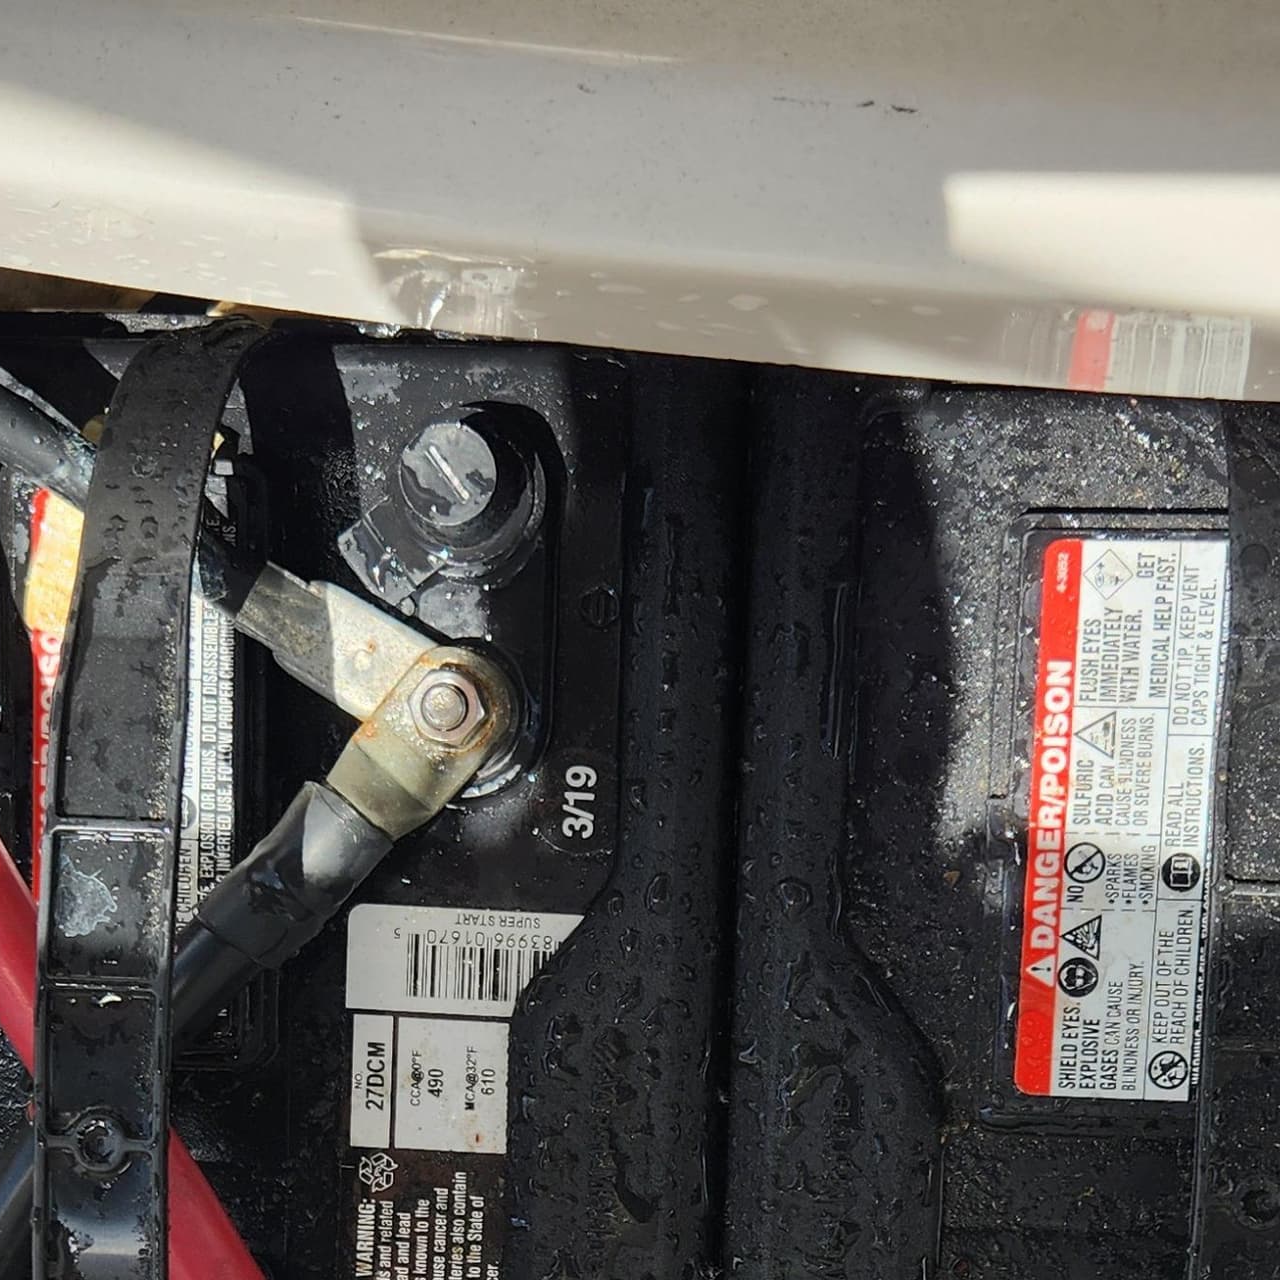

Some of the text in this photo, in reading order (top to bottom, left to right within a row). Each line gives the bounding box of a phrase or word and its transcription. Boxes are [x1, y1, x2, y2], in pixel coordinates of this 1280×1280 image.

[1137, 552, 1155, 578] GET
[1099, 607, 1123, 702] IMMEDIATELY
[1119, 609, 1142, 702] WITH WATER.
[1149, 552, 1176, 697] MEDICAL HELP FAST.
[1173, 565, 1199, 725] DO NOT TIP. KEEP VENT
[1191, 578, 1217, 725] CAPS TIGHT & LEVEL.
[1079, 618, 1101, 701] FLUSH EYES
[201, 727, 217, 742] DO
[202, 697, 217, 723] NOT
[217, 683, 234, 728] PROPER
[216, 733, 233, 781] FOLLOW
[1073, 759, 1093, 824] SULFURIC
[1115, 718, 1136, 825] CAUSE BLINDNESS
[1133, 712, 1155, 825] OR SEVERE BURNS.
[200, 793, 216, 809] OR
[562, 765, 597, 839] 3/19
[1030, 660, 1074, 948] DANGER/POISON
[1095, 764, 1114, 824] ACID CAN
[1165, 782, 1184, 846] READ ALL
[1182, 742, 1205, 847] INSTRUCTIONS.
[200, 813, 216, 878] EXPLOSION
[456, 913, 540, 928] SUPER START
[1067, 885, 1083, 902] NO
[426, 928, 484, 946] 01670
[494, 932, 552, 949] 83996
[1152, 930, 1173, 1043] KEEP OUT OF THE
[1170, 904, 1194, 1043] REACH OF CHILDREN.
[1058, 1001, 1081, 1088] SHIELD EYES.
[1079, 1018, 1099, 1088] EXPLOSIVE
[1100, 981, 1123, 1089] GASES CAN CAUSE
[1121, 960, 1145, 1090] BLINDNESS OR INJURY.
[354, 1071, 362, 1089] NO.
[365, 1041, 385, 1109] 27DCM
[427, 1068, 442, 1097] 490
[481, 1068, 494, 1095] 610
[355, 1197, 376, 1276] WARNING:
